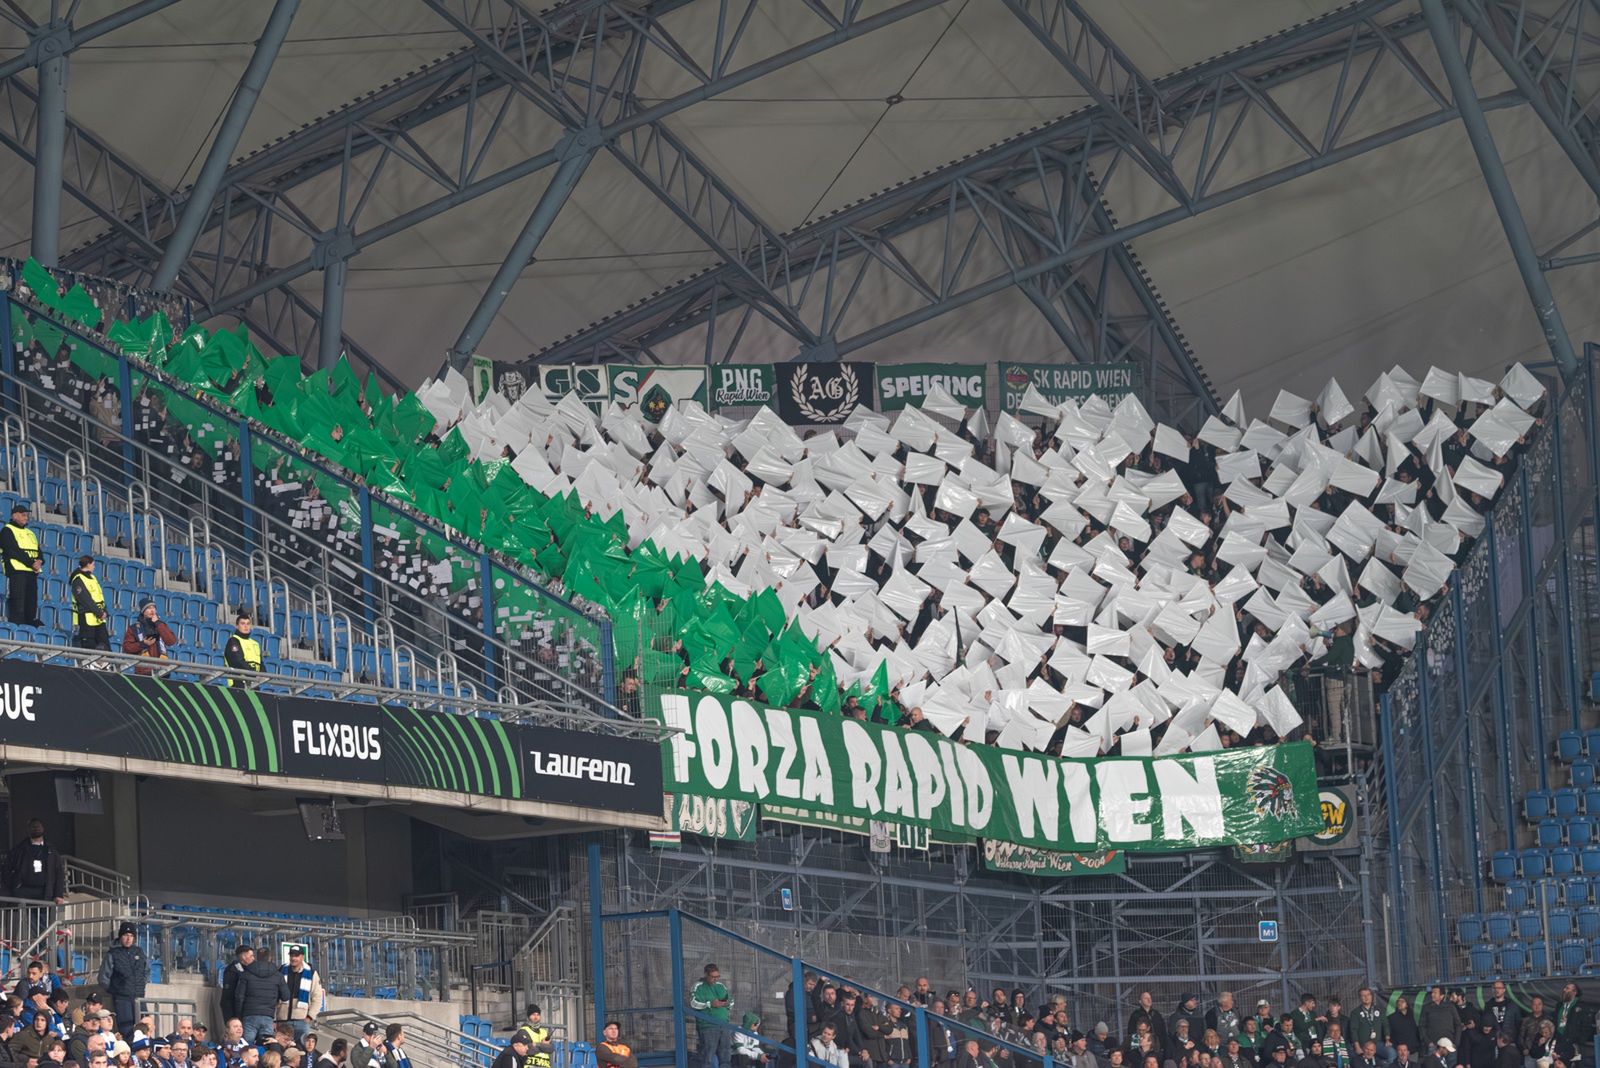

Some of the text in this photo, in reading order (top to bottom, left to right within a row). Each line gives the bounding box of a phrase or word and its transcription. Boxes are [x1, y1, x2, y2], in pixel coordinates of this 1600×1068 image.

[721, 368, 762, 391] PNG
[1033, 369, 1131, 389] SK RAPID WIEN
[716, 389, 770, 405] Rapid Wien
[0, 682, 36, 722] UE
[529, 751, 636, 786] Laufenn
[660, 694, 1225, 844] FORZA RAPID WIEN
[1262, 928, 1275, 937] M1
